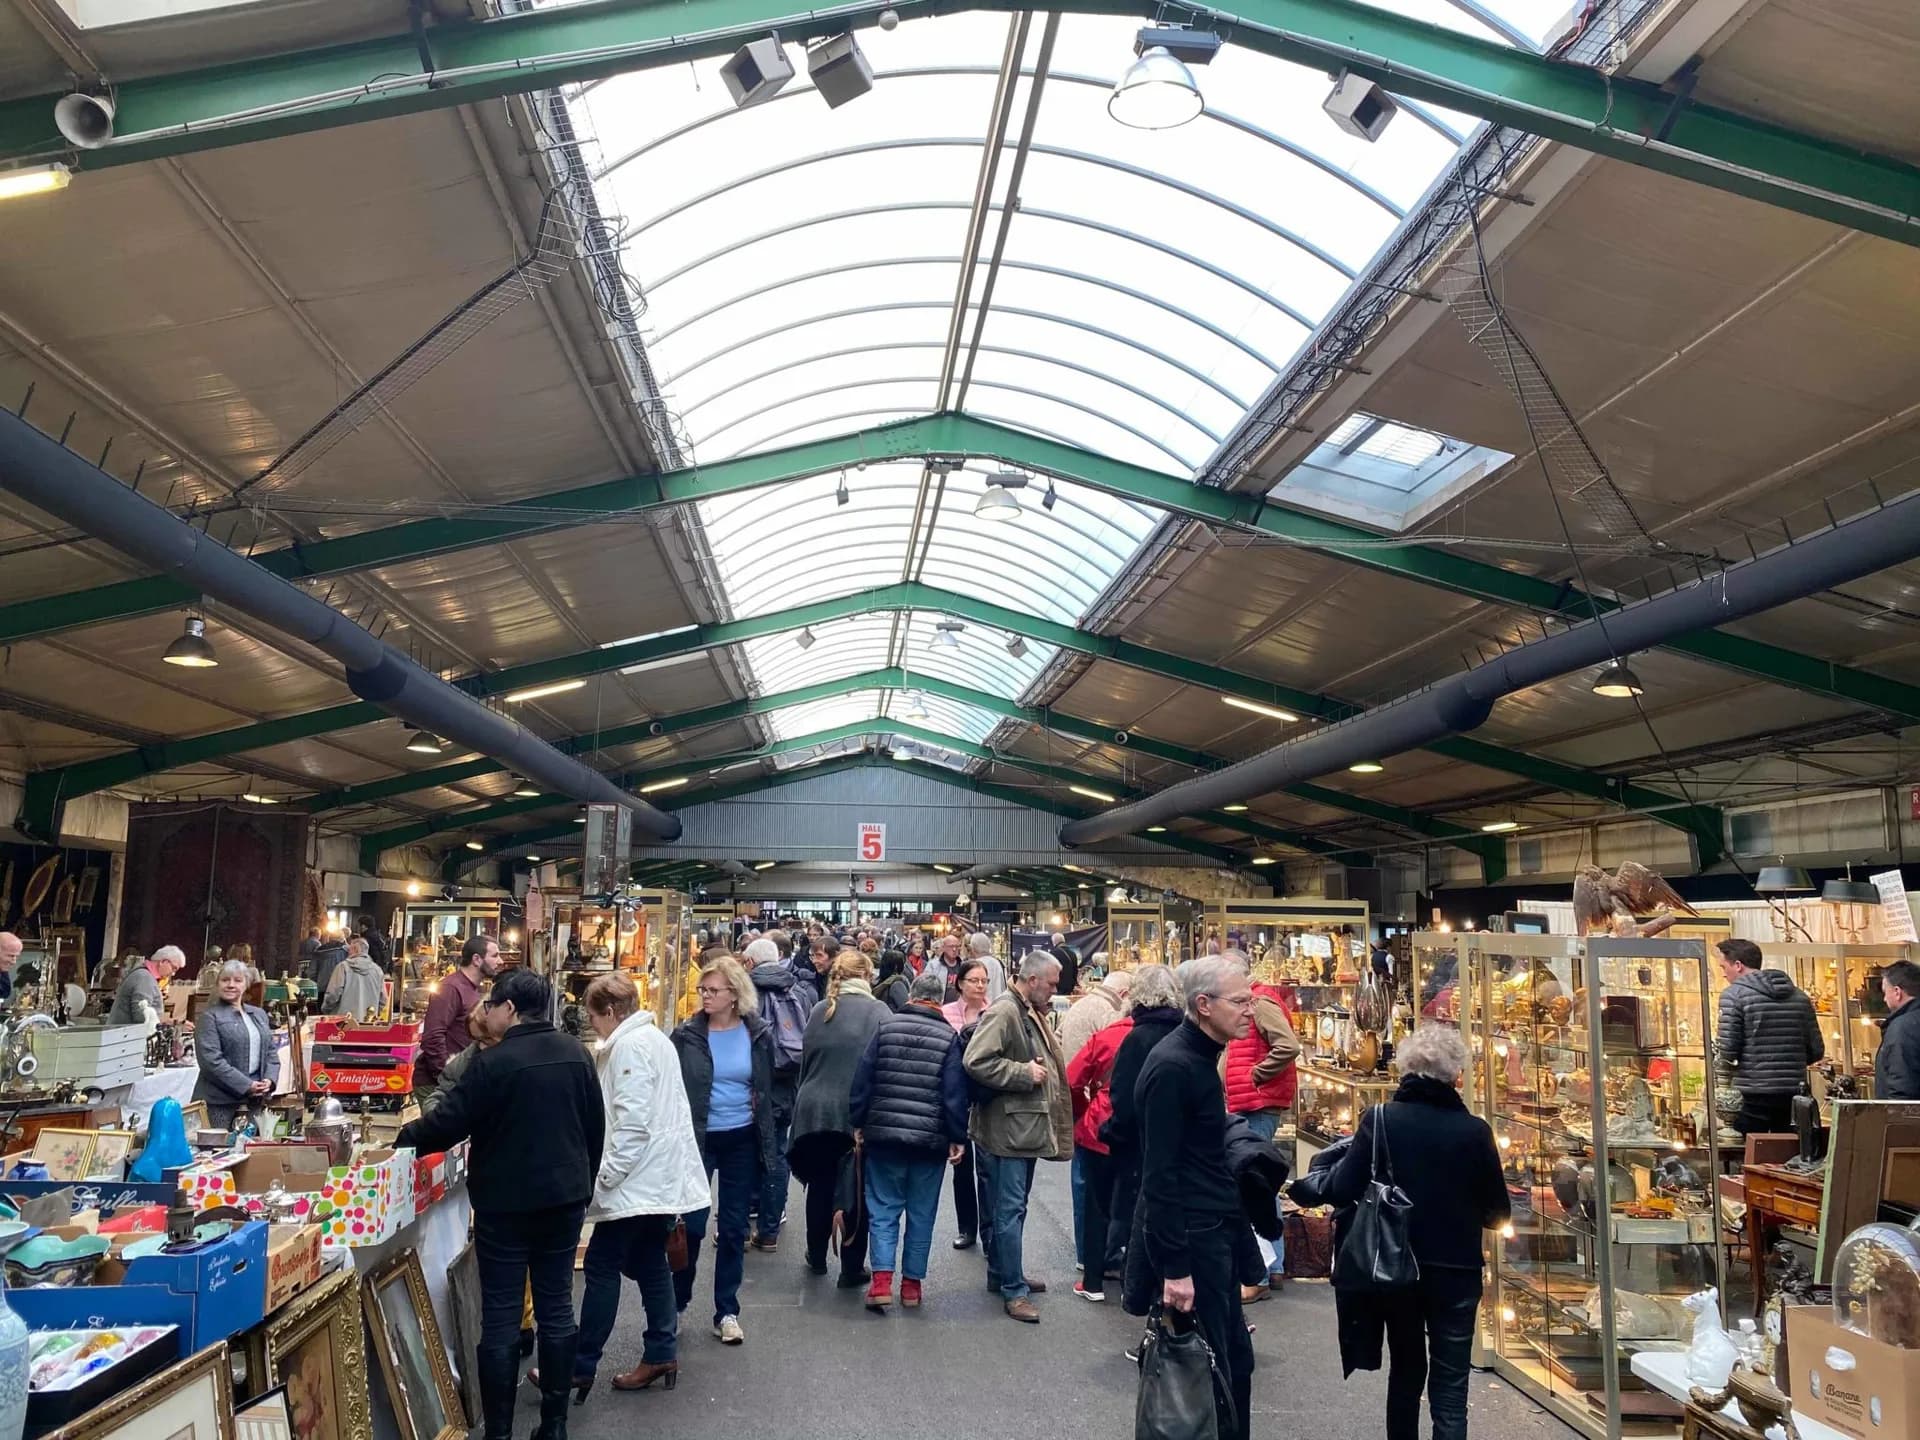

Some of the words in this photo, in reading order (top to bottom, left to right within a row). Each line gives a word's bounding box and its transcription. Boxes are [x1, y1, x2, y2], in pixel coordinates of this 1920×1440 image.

[862, 824, 882, 832] HALL
[862, 833, 882, 860] 5
[865, 880, 874, 893] 5
